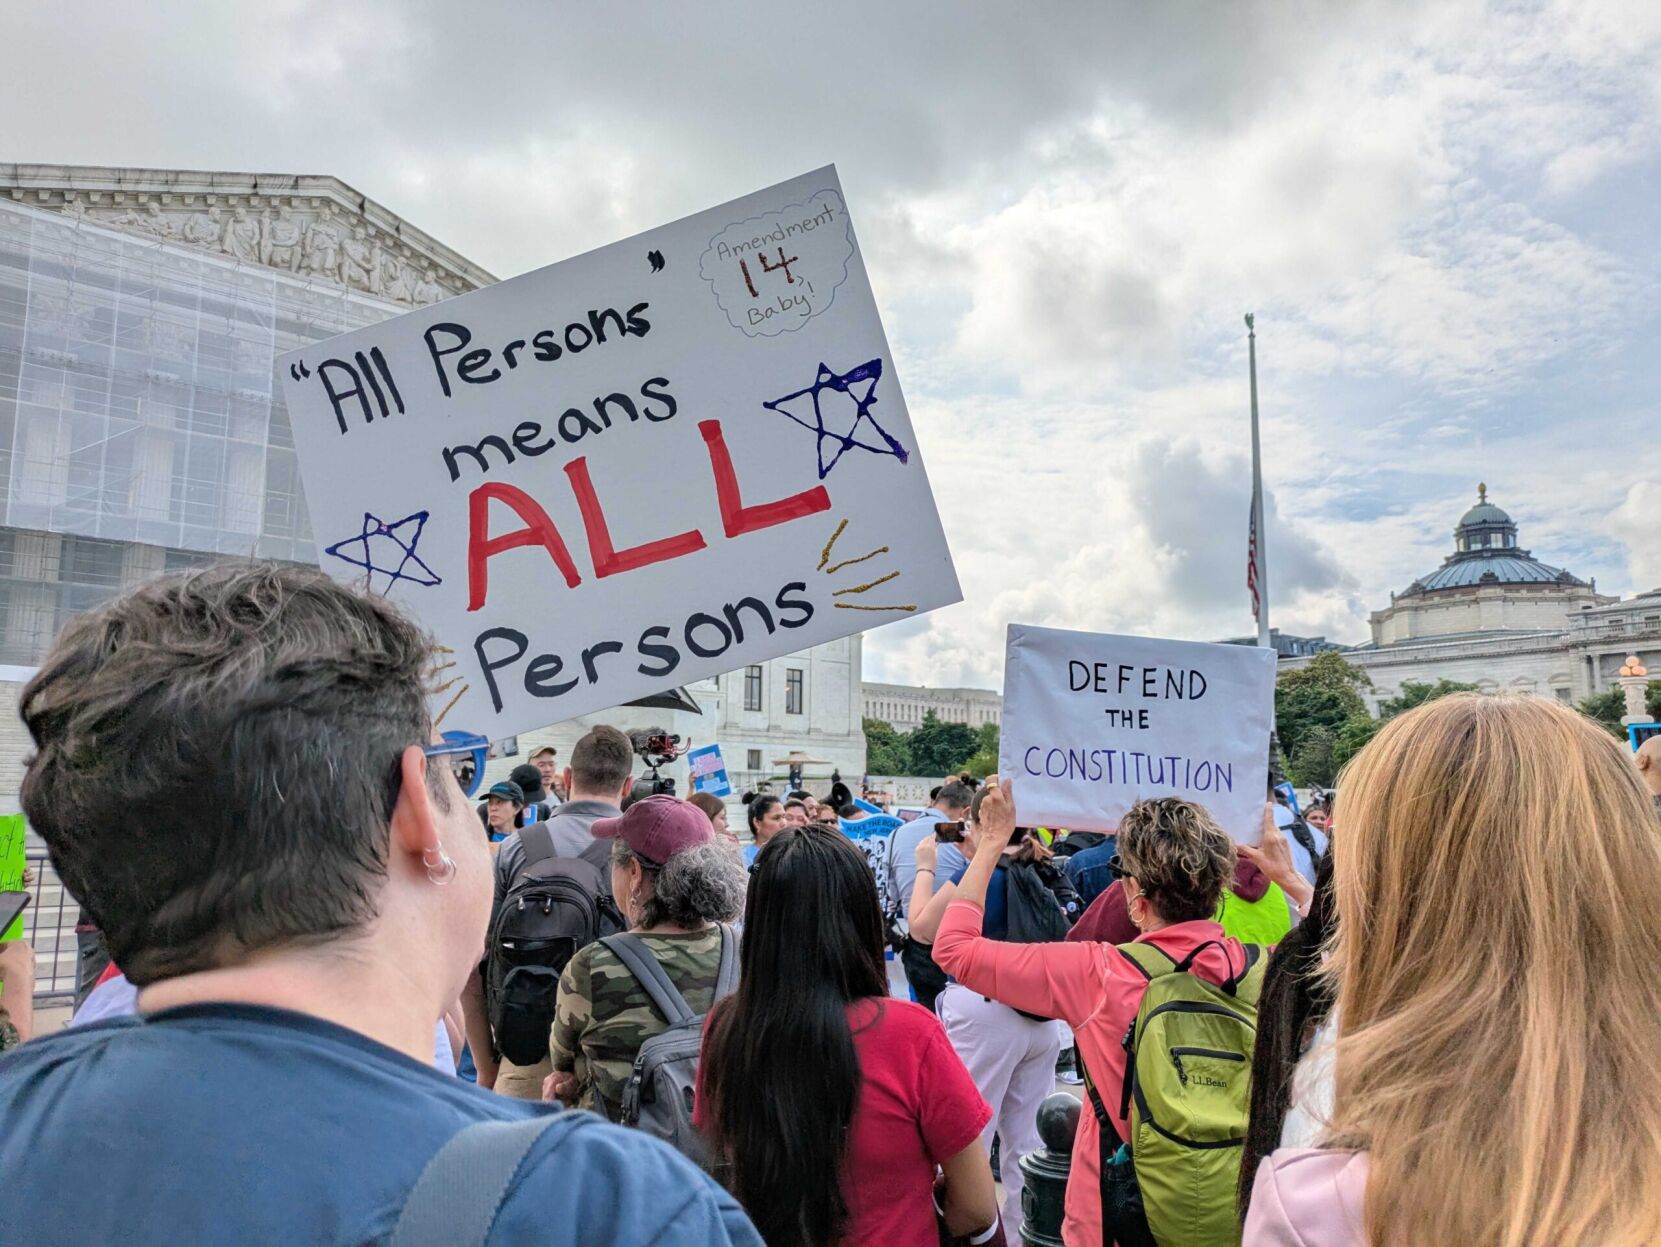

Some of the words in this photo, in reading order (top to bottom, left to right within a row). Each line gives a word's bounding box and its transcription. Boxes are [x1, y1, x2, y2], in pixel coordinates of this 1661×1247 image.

[717, 203, 834, 261] Amendment
[747, 281, 815, 326] Baby!
[442, 376, 678, 482] means
[467, 419, 832, 612] ALL
[474, 581, 815, 714] Persons
[1069, 660, 1207, 700] DEFEND
[1105, 709, 1149, 729] THE
[1024, 746, 1232, 792] CONSTITUTION
[868, 818, 881, 827] THE
[1192, 1075, 1227, 1088] L.L.Bean
